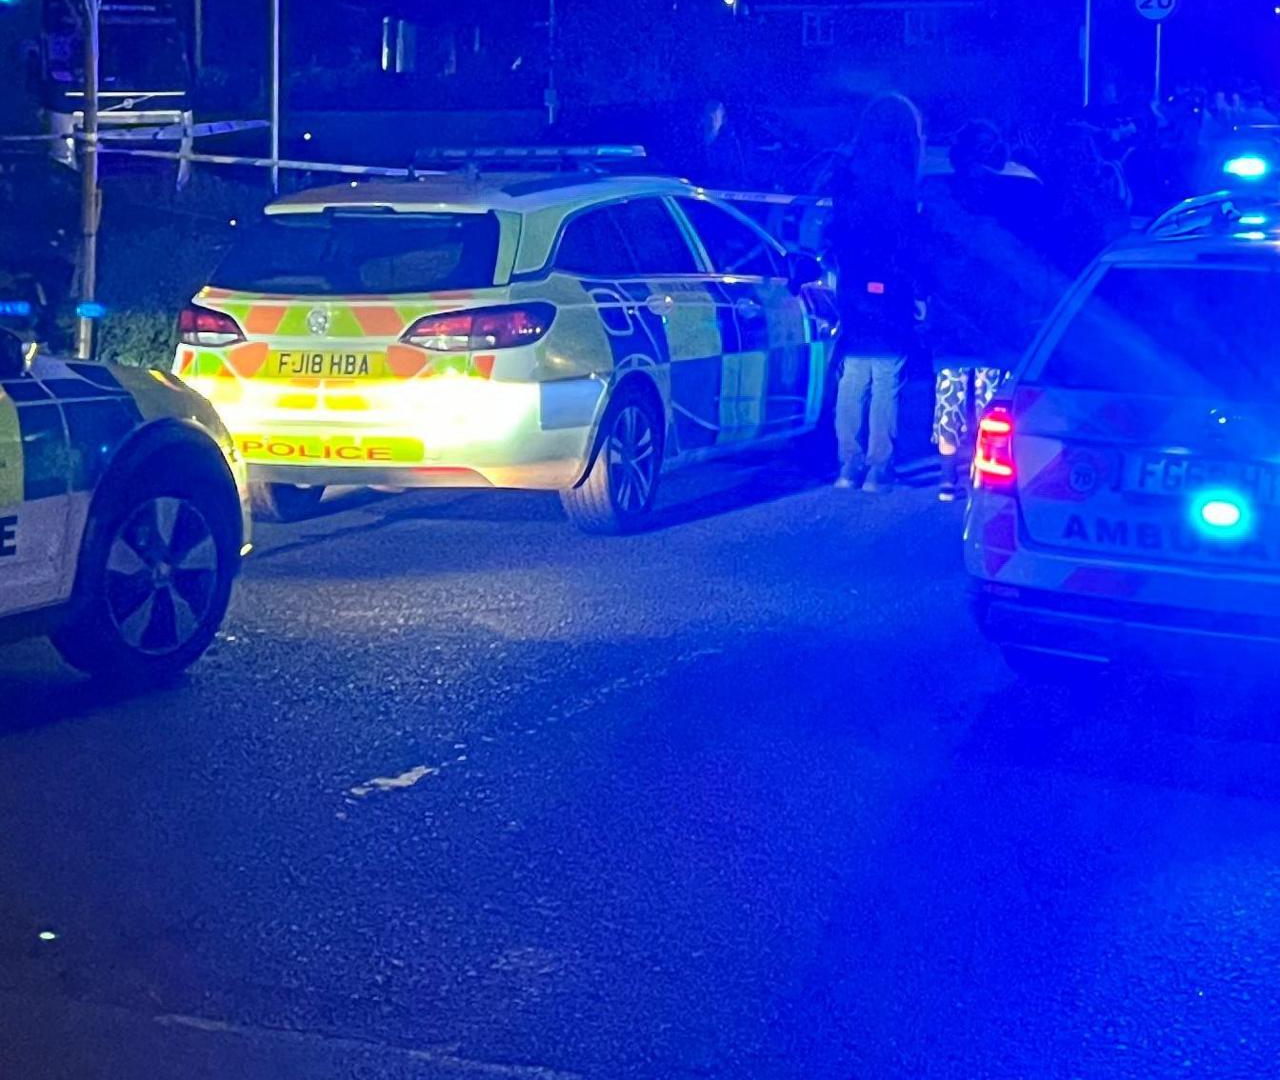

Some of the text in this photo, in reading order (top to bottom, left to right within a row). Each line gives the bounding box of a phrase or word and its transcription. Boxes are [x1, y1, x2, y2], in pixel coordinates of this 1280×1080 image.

[278, 353, 369, 375] FJ18 HBA
[241, 440, 393, 461] POLICE
